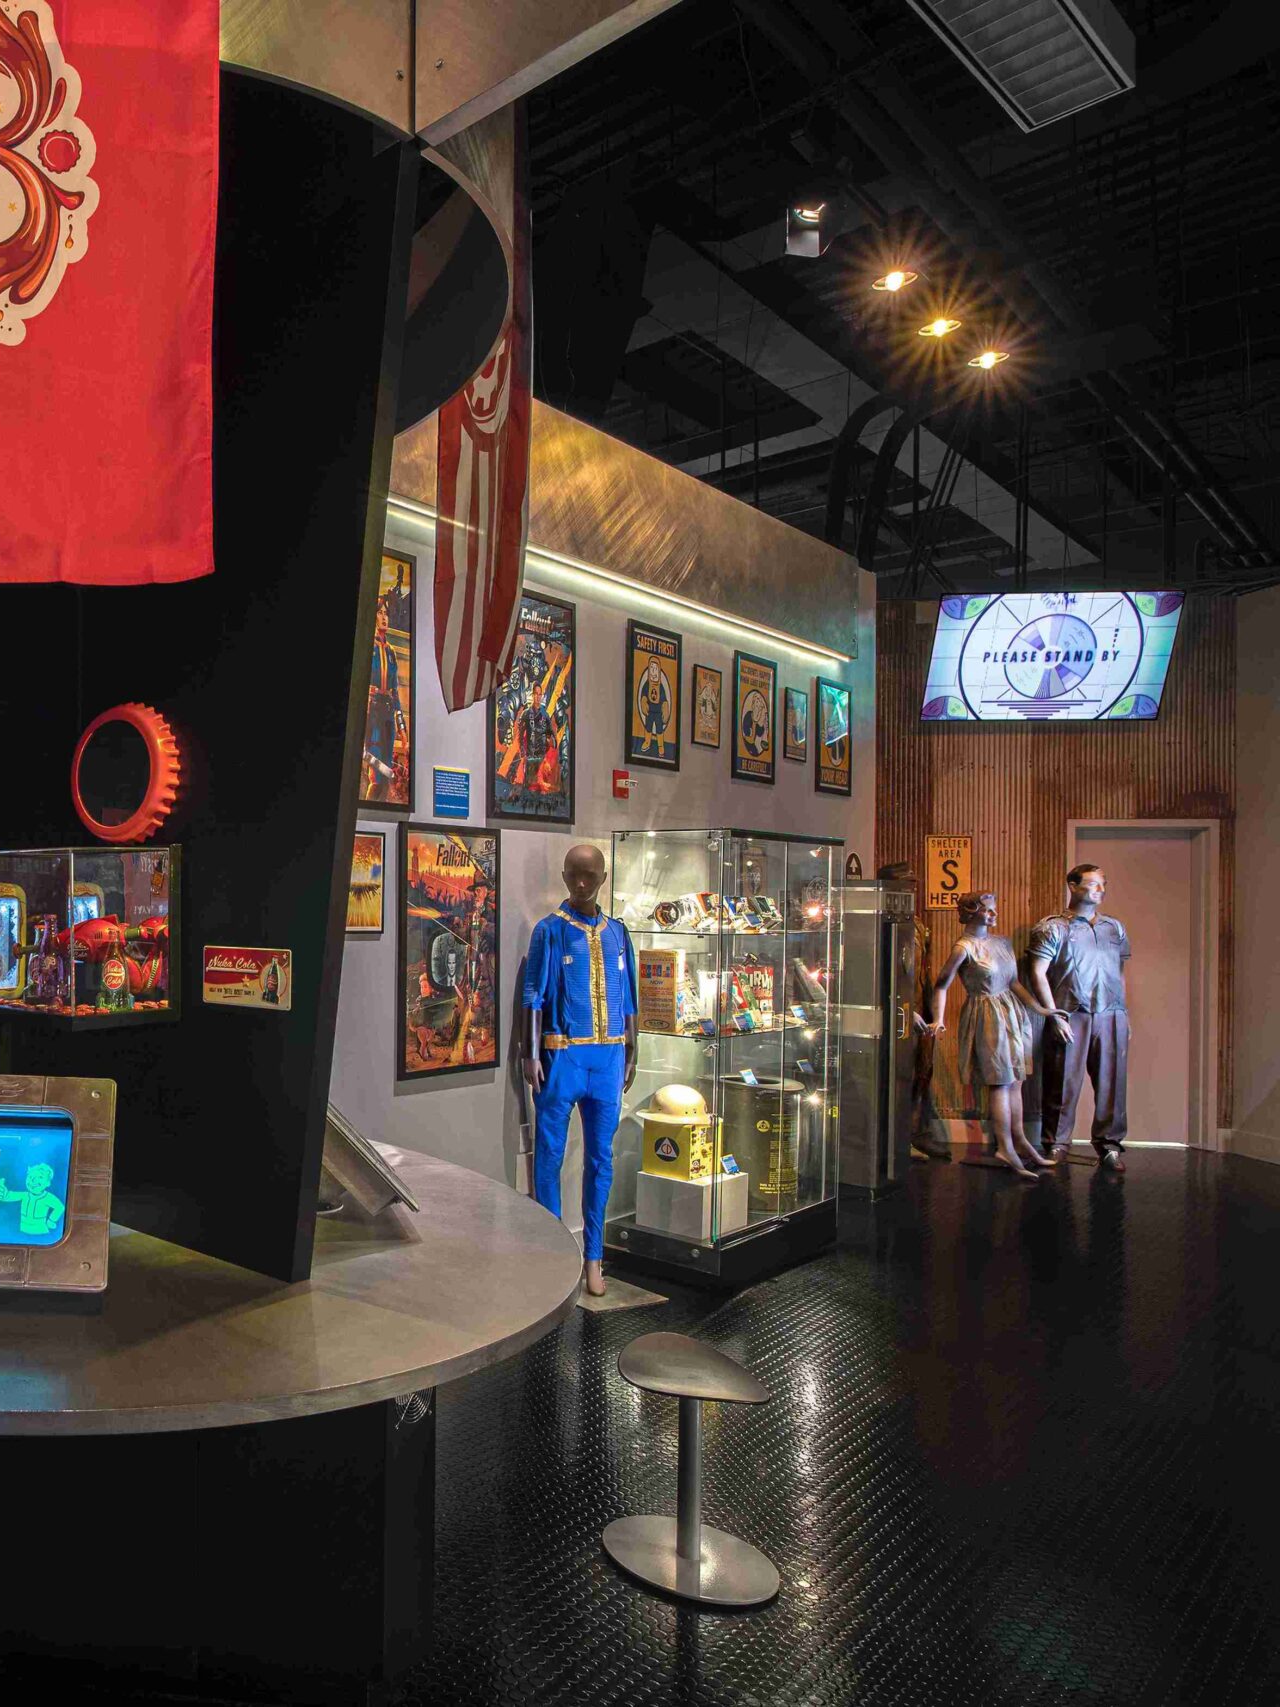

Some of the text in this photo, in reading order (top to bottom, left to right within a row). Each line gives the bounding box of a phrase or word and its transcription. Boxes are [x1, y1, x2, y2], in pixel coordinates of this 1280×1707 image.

[637, 635, 657, 652] SAFETY
[983, 651, 1120, 663] PLEASE STAND BY
[931, 840, 968, 848] SHELTER
[436, 844, 471, 867] Fallout
[938, 850, 961, 858] AREA
[940, 859, 959, 891] S
[208, 954, 257, 969] Nuka Cola
